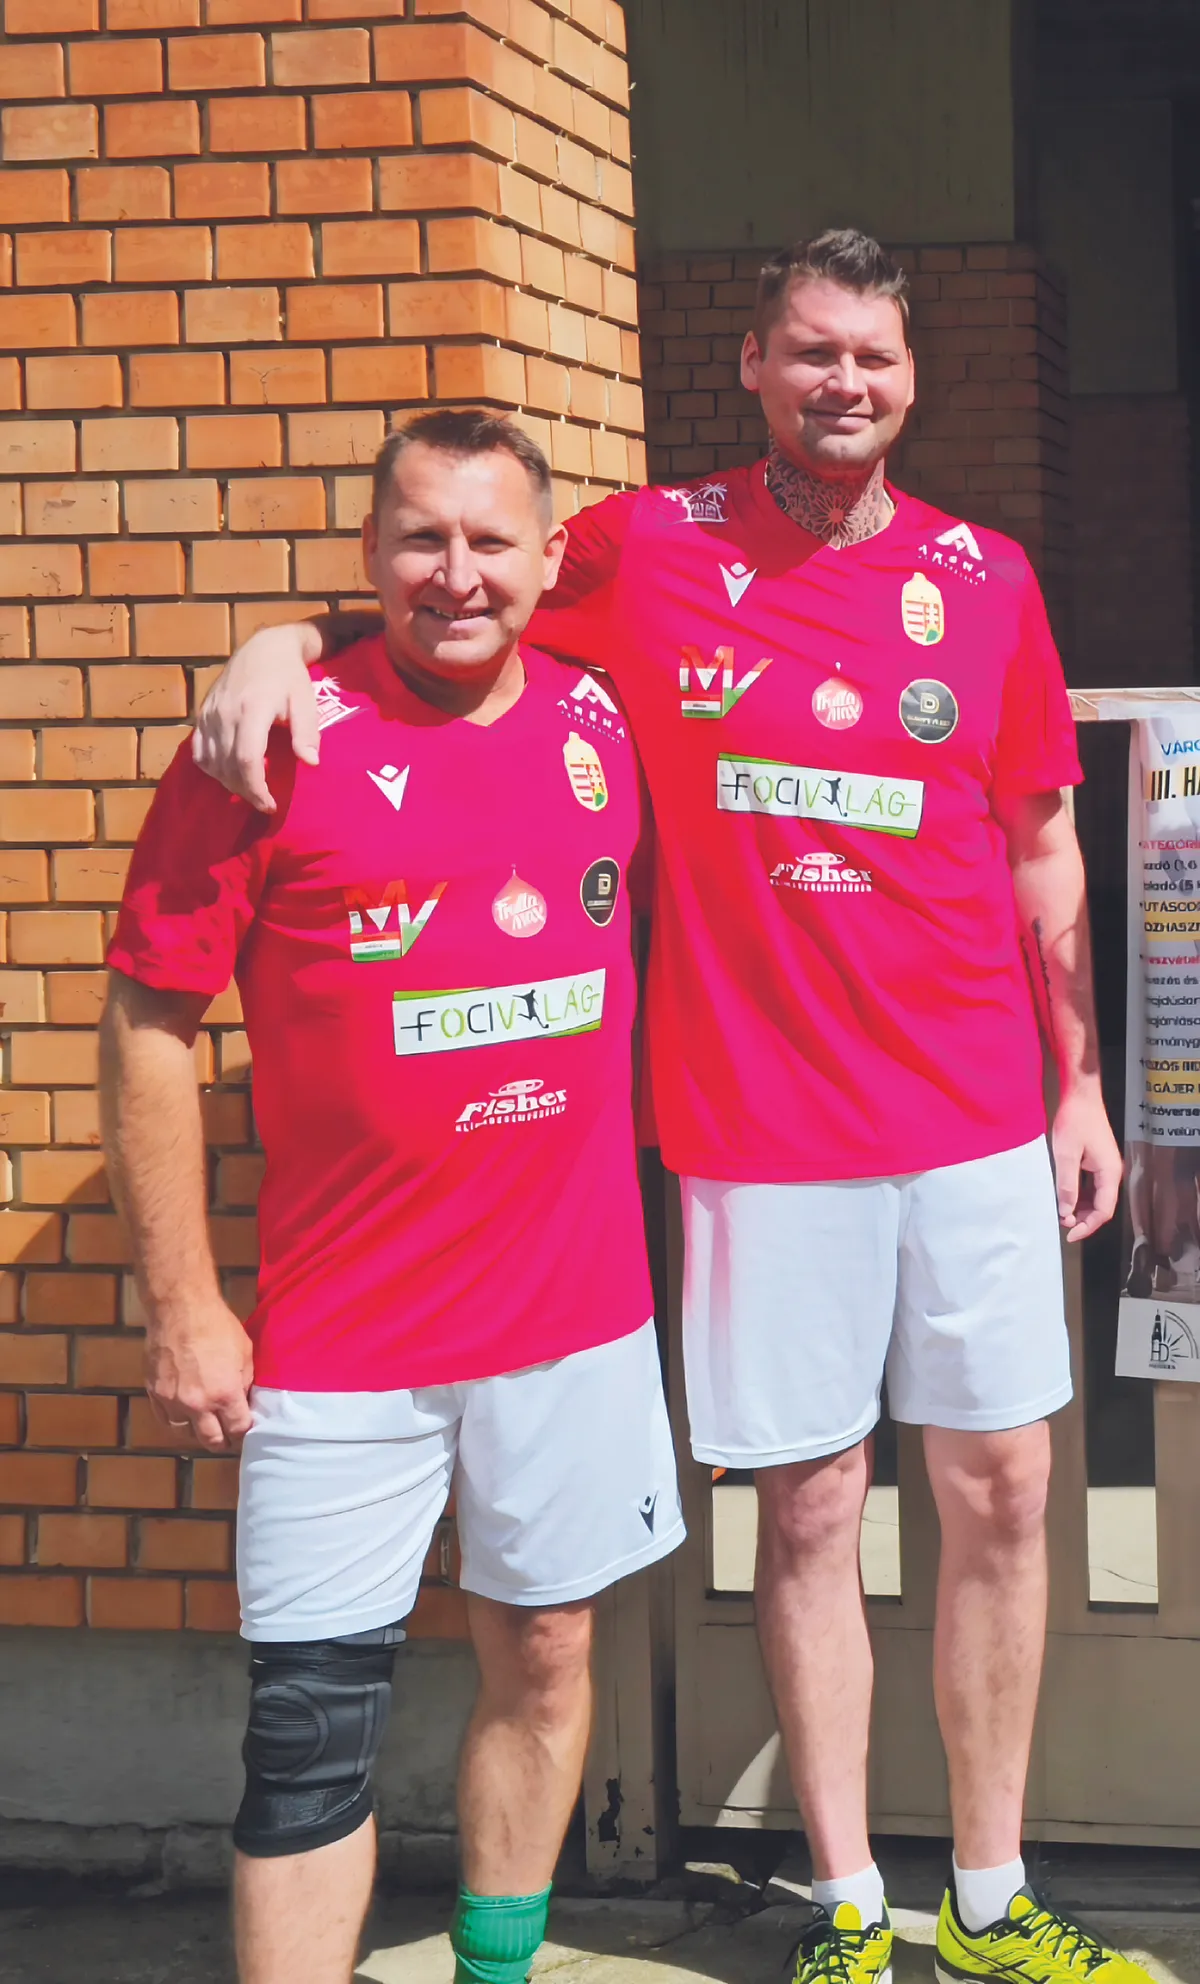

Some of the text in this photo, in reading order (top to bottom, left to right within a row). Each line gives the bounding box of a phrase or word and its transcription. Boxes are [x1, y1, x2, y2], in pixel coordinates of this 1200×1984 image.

[1151, 769, 1176, 801] III.
[770, 862, 872, 882] Fisher
[456, 1089, 567, 1123] Fisher
